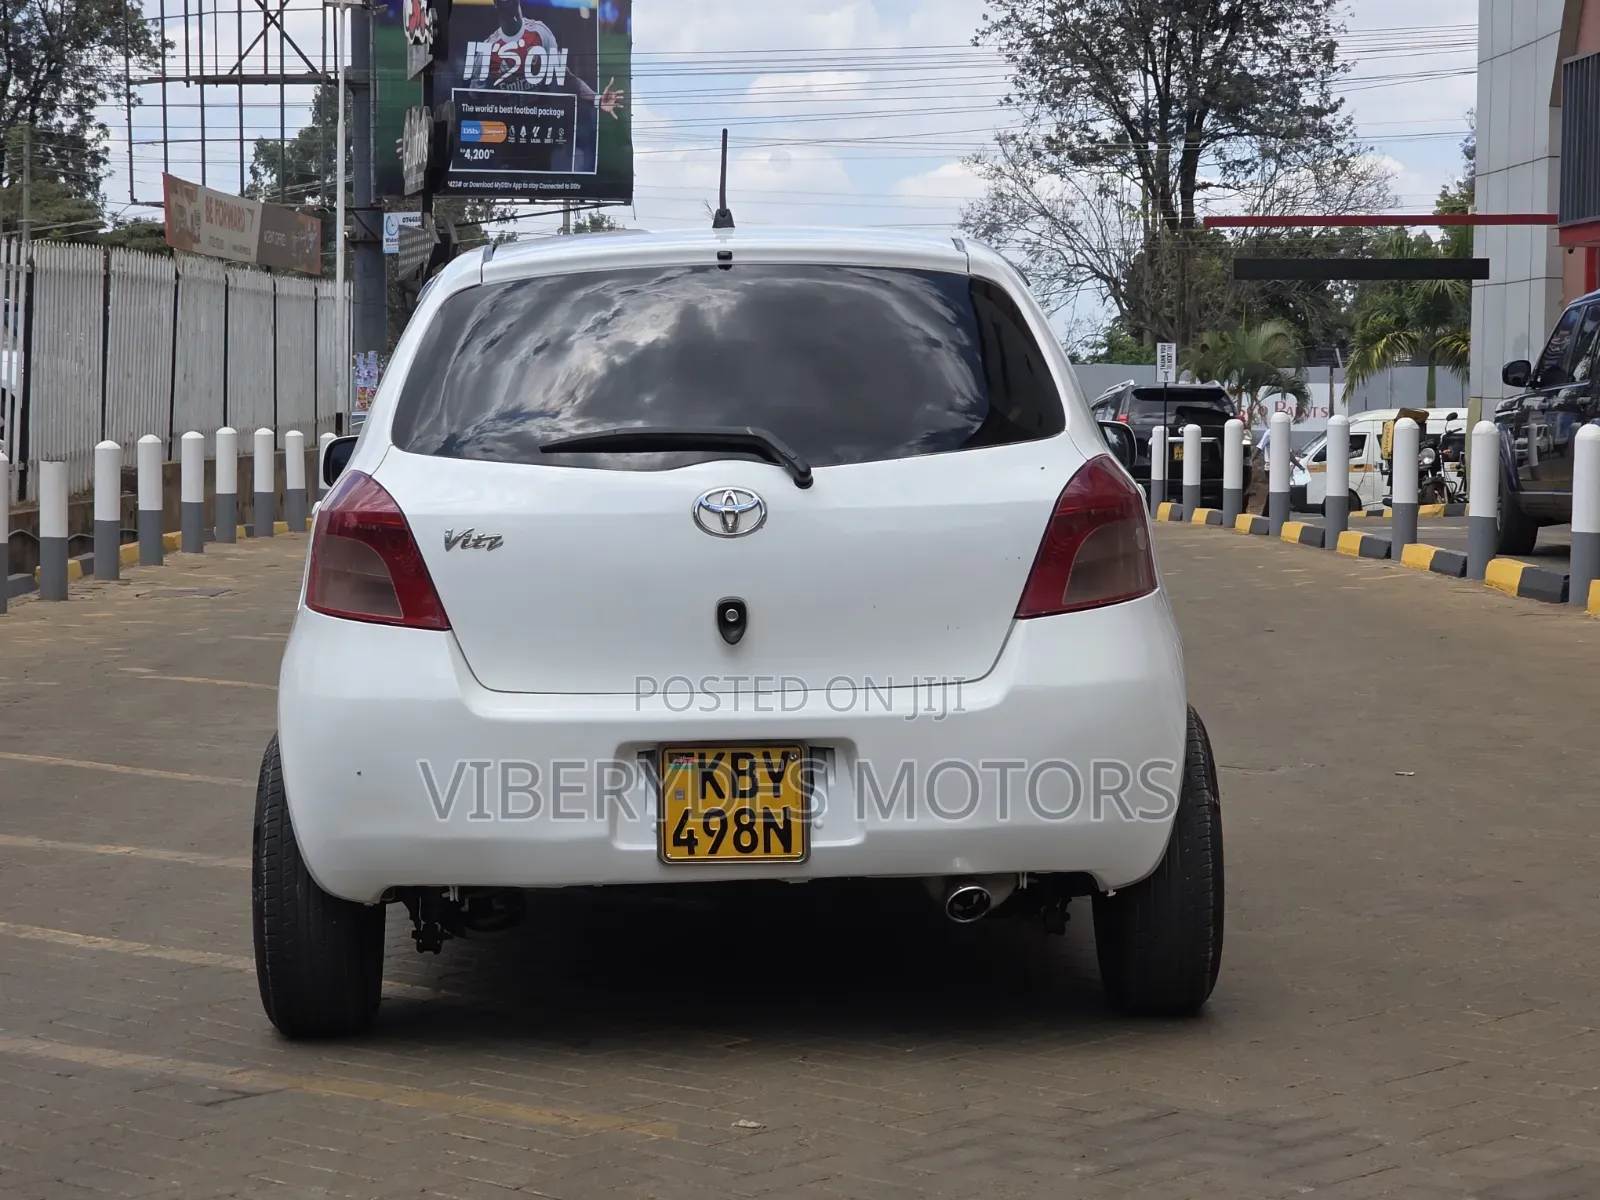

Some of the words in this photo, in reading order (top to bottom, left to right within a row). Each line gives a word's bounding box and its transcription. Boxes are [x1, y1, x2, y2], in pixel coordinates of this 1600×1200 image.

[463, 39, 525, 86] IT'S
[524, 45, 568, 86] ON
[462, 103, 474, 112] The
[475, 104, 498, 113] world's
[499, 105, 513, 114] best
[514, 106, 537, 115] football
[538, 107, 565, 118] package
[463, 127, 480, 135] DStv
[464, 148, 490, 161] 4,200
[513, 182, 522, 190] App
[539, 182, 564, 190] Connected
[444, 527, 504, 552] Vitz
[698, 751, 790, 800] KBY
[672, 806, 792, 856] 498N
